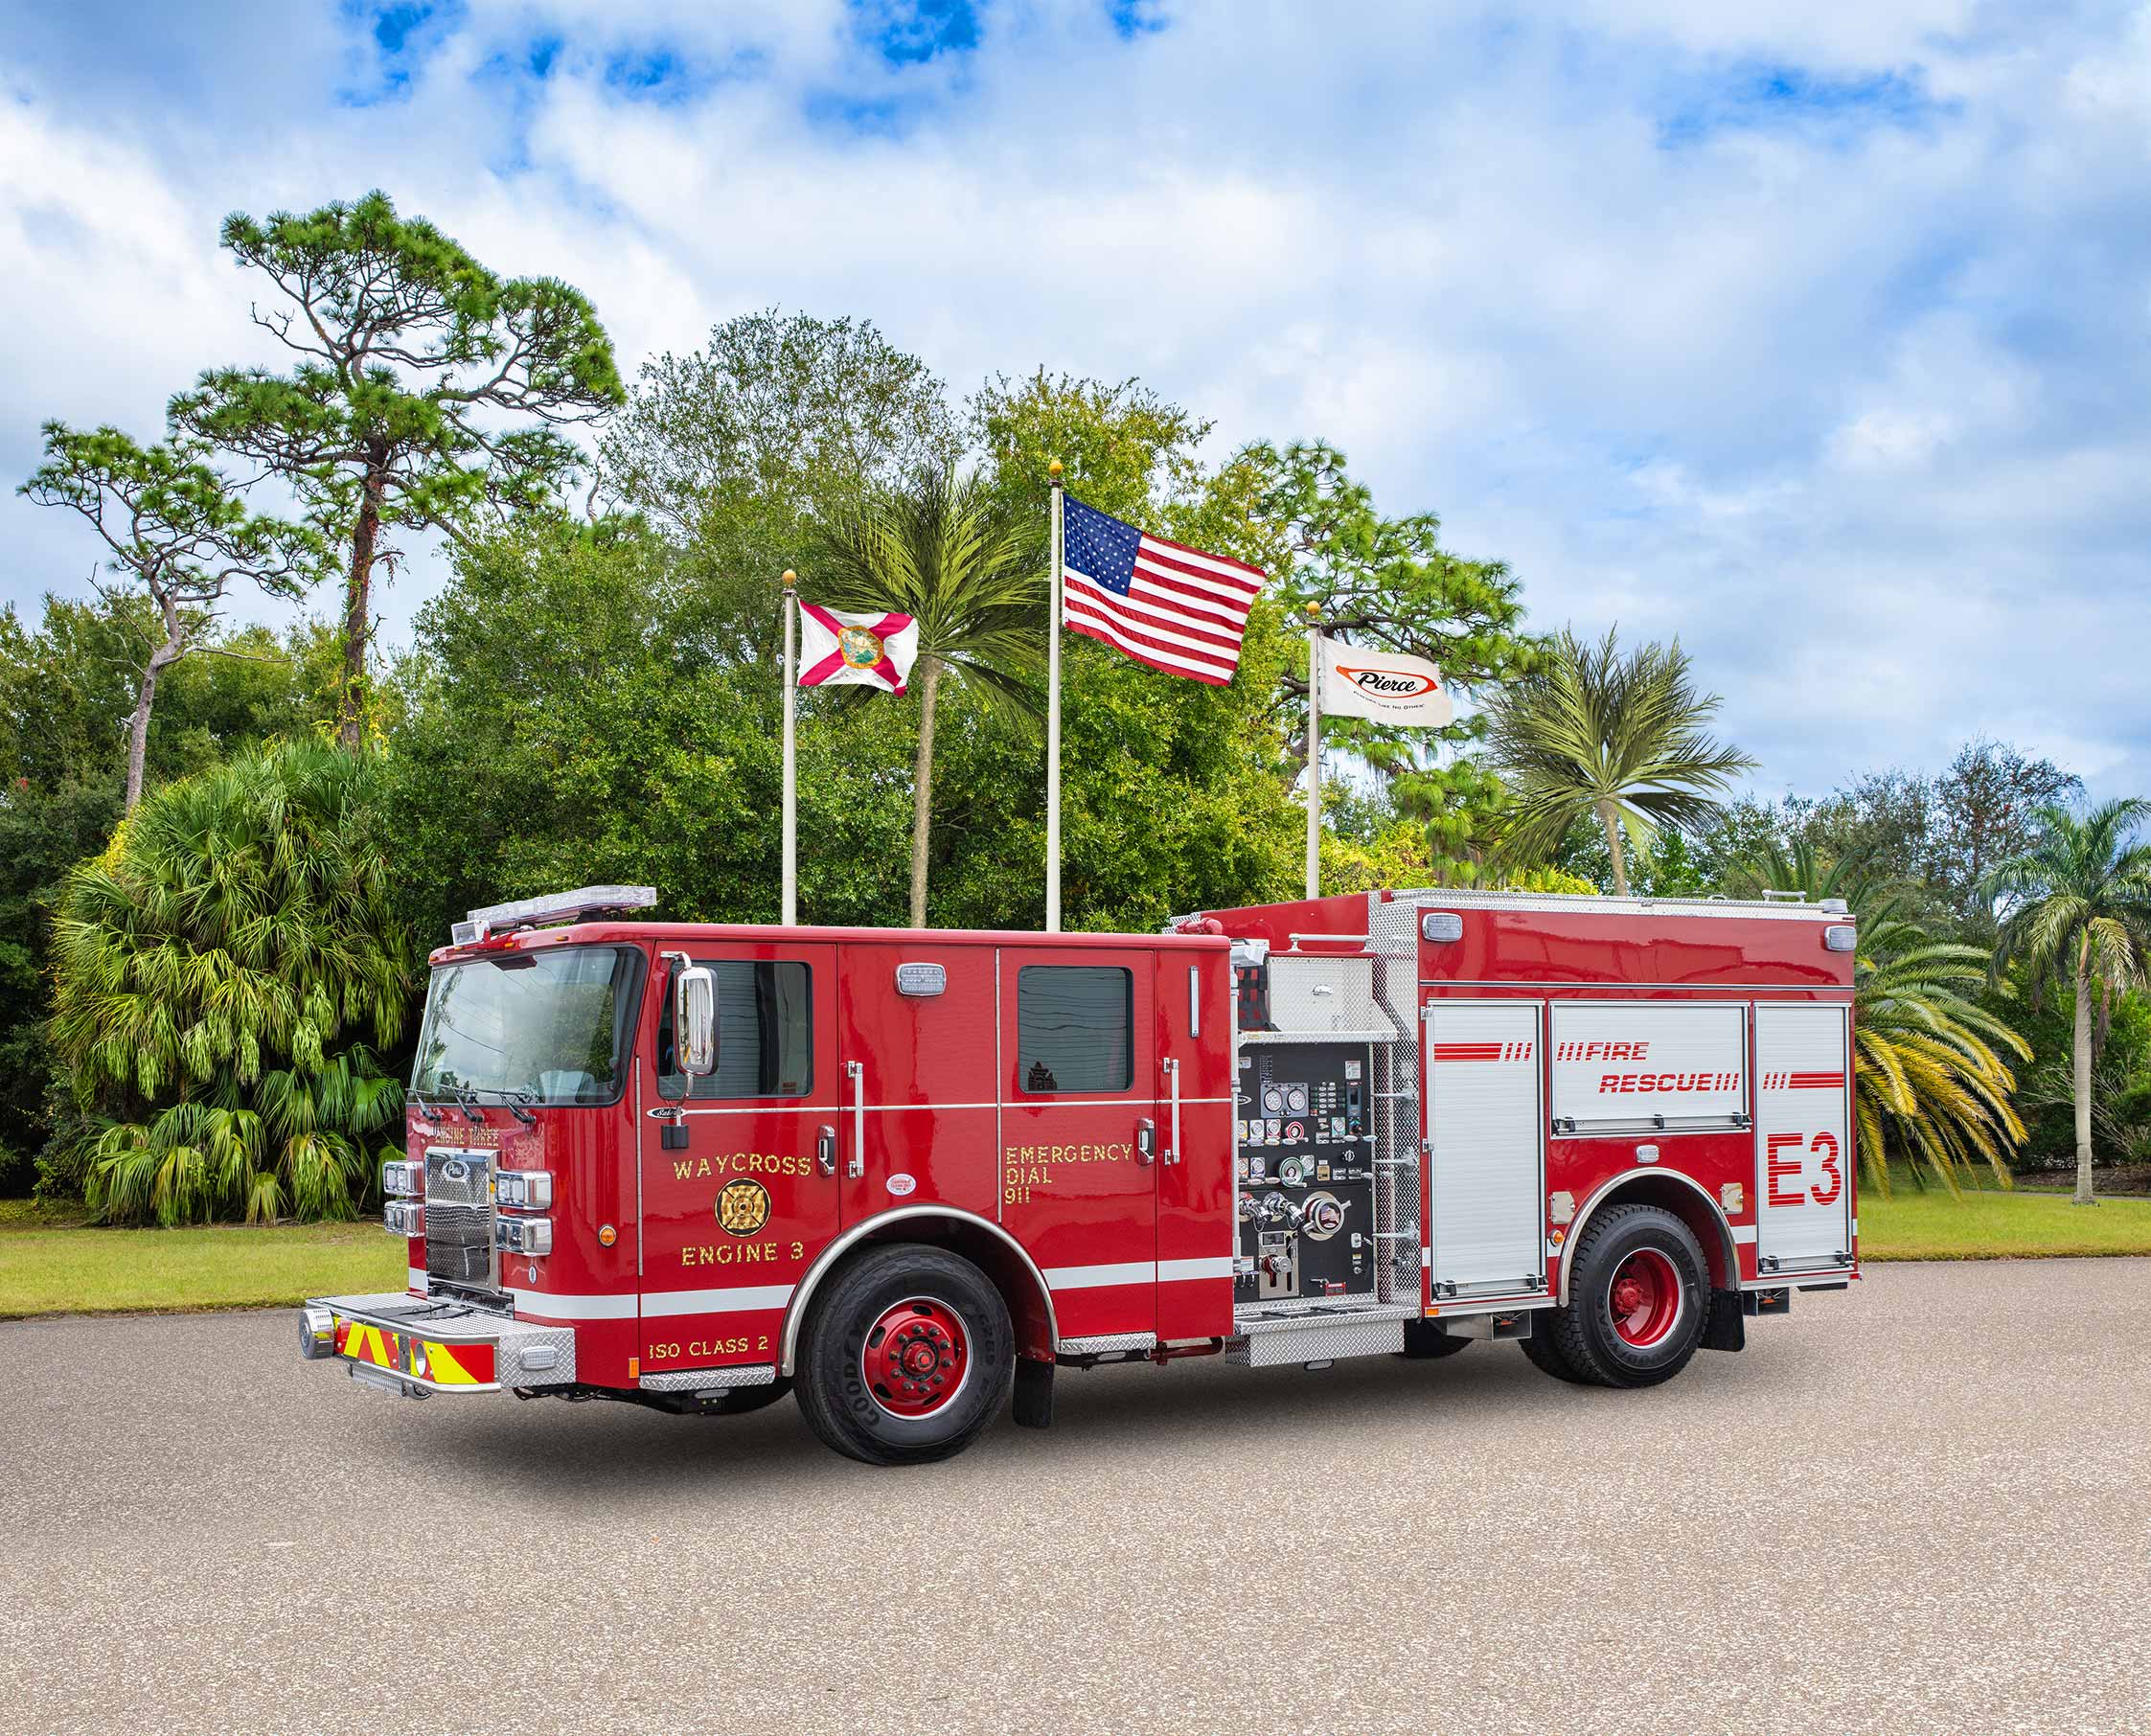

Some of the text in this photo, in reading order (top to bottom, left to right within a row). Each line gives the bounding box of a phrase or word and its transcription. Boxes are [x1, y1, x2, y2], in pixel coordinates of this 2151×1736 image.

[1358, 672, 1417, 692] Pierce
[1585, 1042, 1650, 1061] FIRE
[1599, 1073, 1713, 1093] RESCUE
[1006, 1144, 1133, 1164] EMERGENCY
[674, 1153, 812, 1180] WAYCROSS
[1006, 1167, 1053, 1185] DIAL
[1767, 1131, 1842, 1208] E3
[1004, 1187, 1030, 1204] 911
[681, 1242, 804, 1267] ENGINE 3
[649, 1336, 768, 1359] ISO CLASS 2
